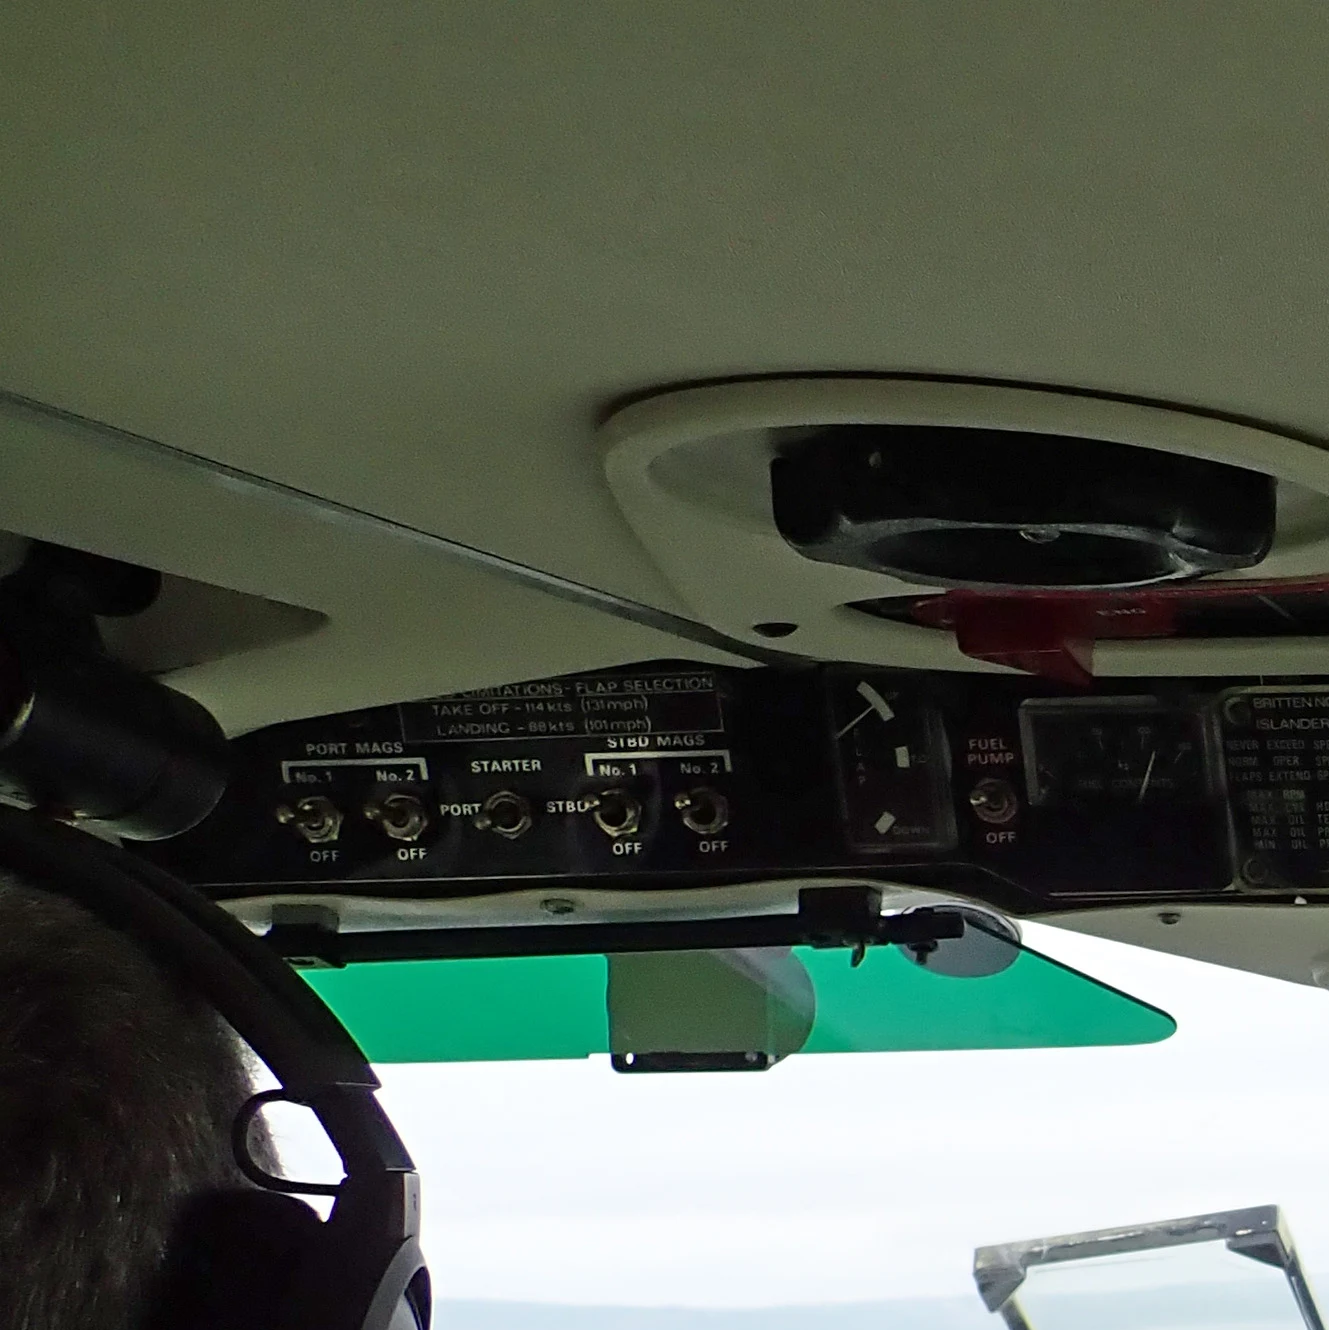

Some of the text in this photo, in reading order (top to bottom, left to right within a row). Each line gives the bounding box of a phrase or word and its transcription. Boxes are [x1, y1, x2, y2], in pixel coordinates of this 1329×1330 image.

[576, 682, 617, 695] FLAP
[623, 677, 714, 692] SELECTION
[432, 703, 473, 716] TAKE
[479, 702, 509, 715] OFF
[1252, 696, 1313, 709] BRITTEN
[437, 721, 511, 737] LANDING
[1256, 718, 1329, 730] ISLANDER
[606, 734, 706, 748] STBD MAGS
[968, 738, 1008, 751] FUEL
[1266, 739, 1305, 750] EXCEED
[306, 741, 404, 756] PORT MAGS
[966, 752, 1014, 766] PUMP
[470, 759, 542, 774] STARTER
[600, 764, 625, 776] No.
[680, 762, 720, 775] No. 2
[376, 769, 415, 782] No. 2
[1269, 770, 1311, 781] EXTEND
[440, 803, 482, 816] PORT
[547, 801, 590, 814] STBD
[986, 831, 1017, 844] OFF
[612, 842, 643, 855] OFF
[700, 840, 730, 853] OFF
[310, 850, 341, 862] OFF
[397, 848, 428, 861] OFF
